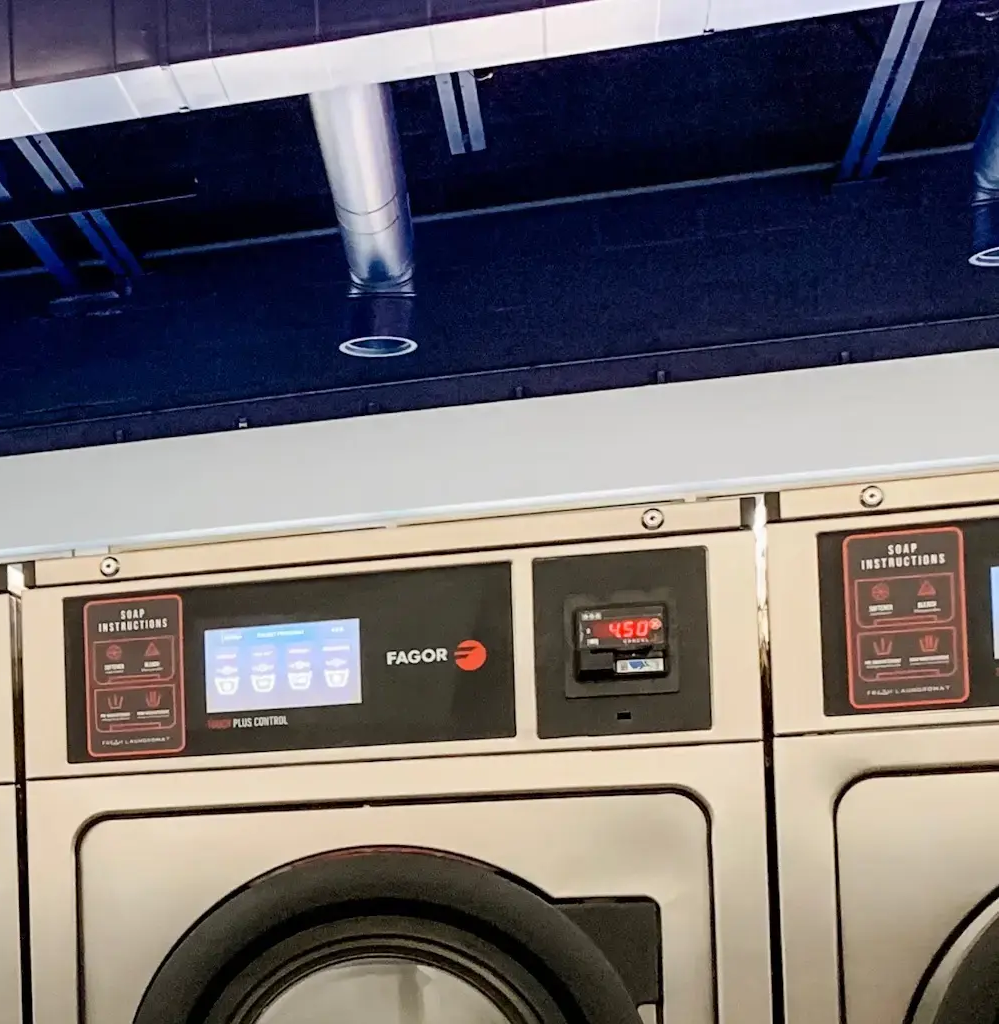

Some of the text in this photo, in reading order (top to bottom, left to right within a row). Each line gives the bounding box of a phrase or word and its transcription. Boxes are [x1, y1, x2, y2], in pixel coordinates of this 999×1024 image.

[887, 543, 918, 555] SOAP
[861, 553, 946, 570] INSTRUCTIONS
[120, 608, 145, 620] SOAP
[98, 618, 168, 633] INSTRUCTIONS
[386, 647, 448, 665] FAGOR
[232, 717, 253, 728] PLUS
[254, 715, 288, 727] CONTROL
